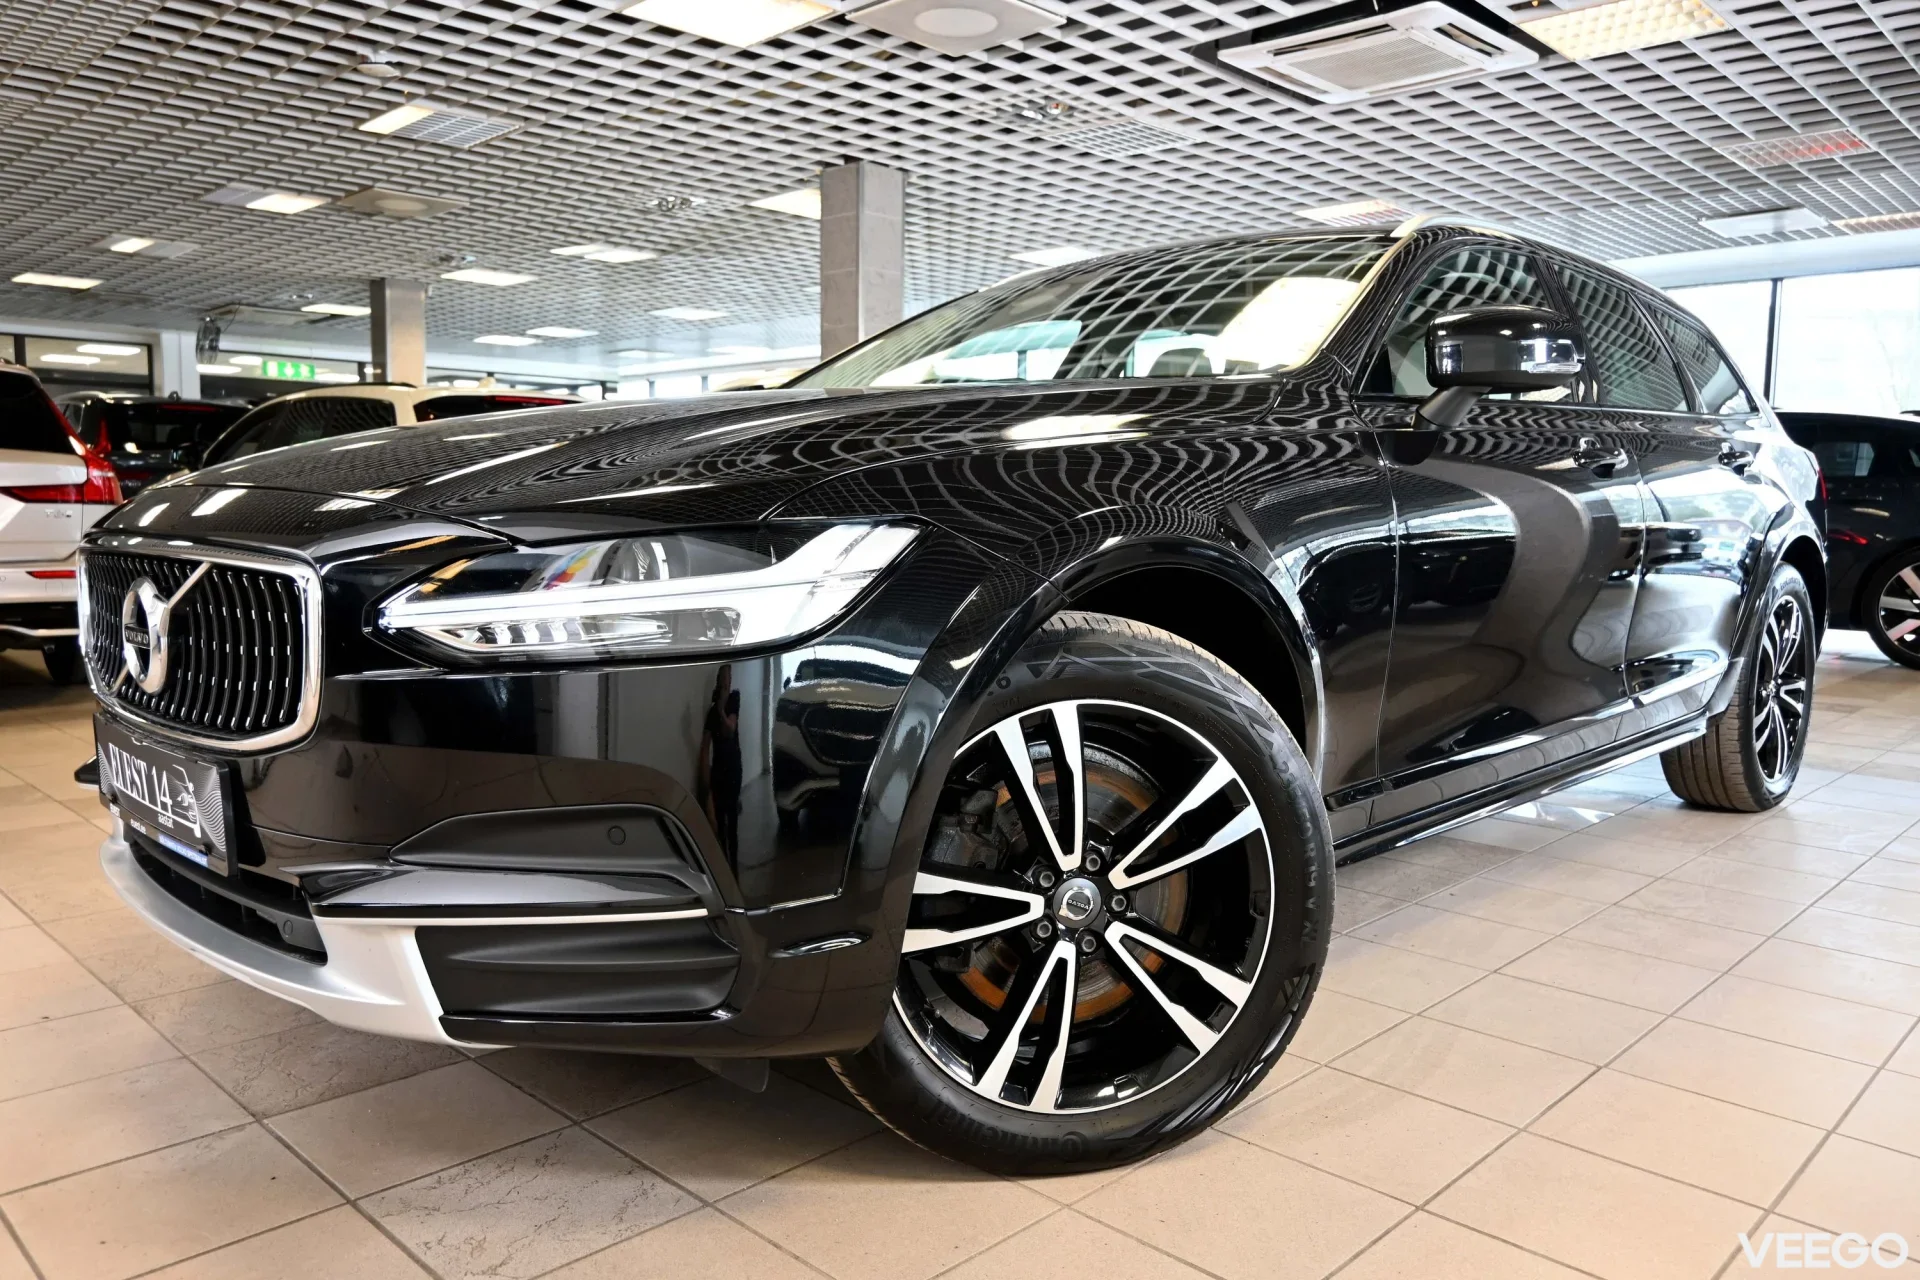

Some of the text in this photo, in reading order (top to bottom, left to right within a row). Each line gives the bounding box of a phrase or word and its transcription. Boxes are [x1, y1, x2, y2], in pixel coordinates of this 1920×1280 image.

[125, 629, 149, 645] VOLVO
[151, 765, 173, 816] 14
[1067, 899, 1089, 910] VOLVO
